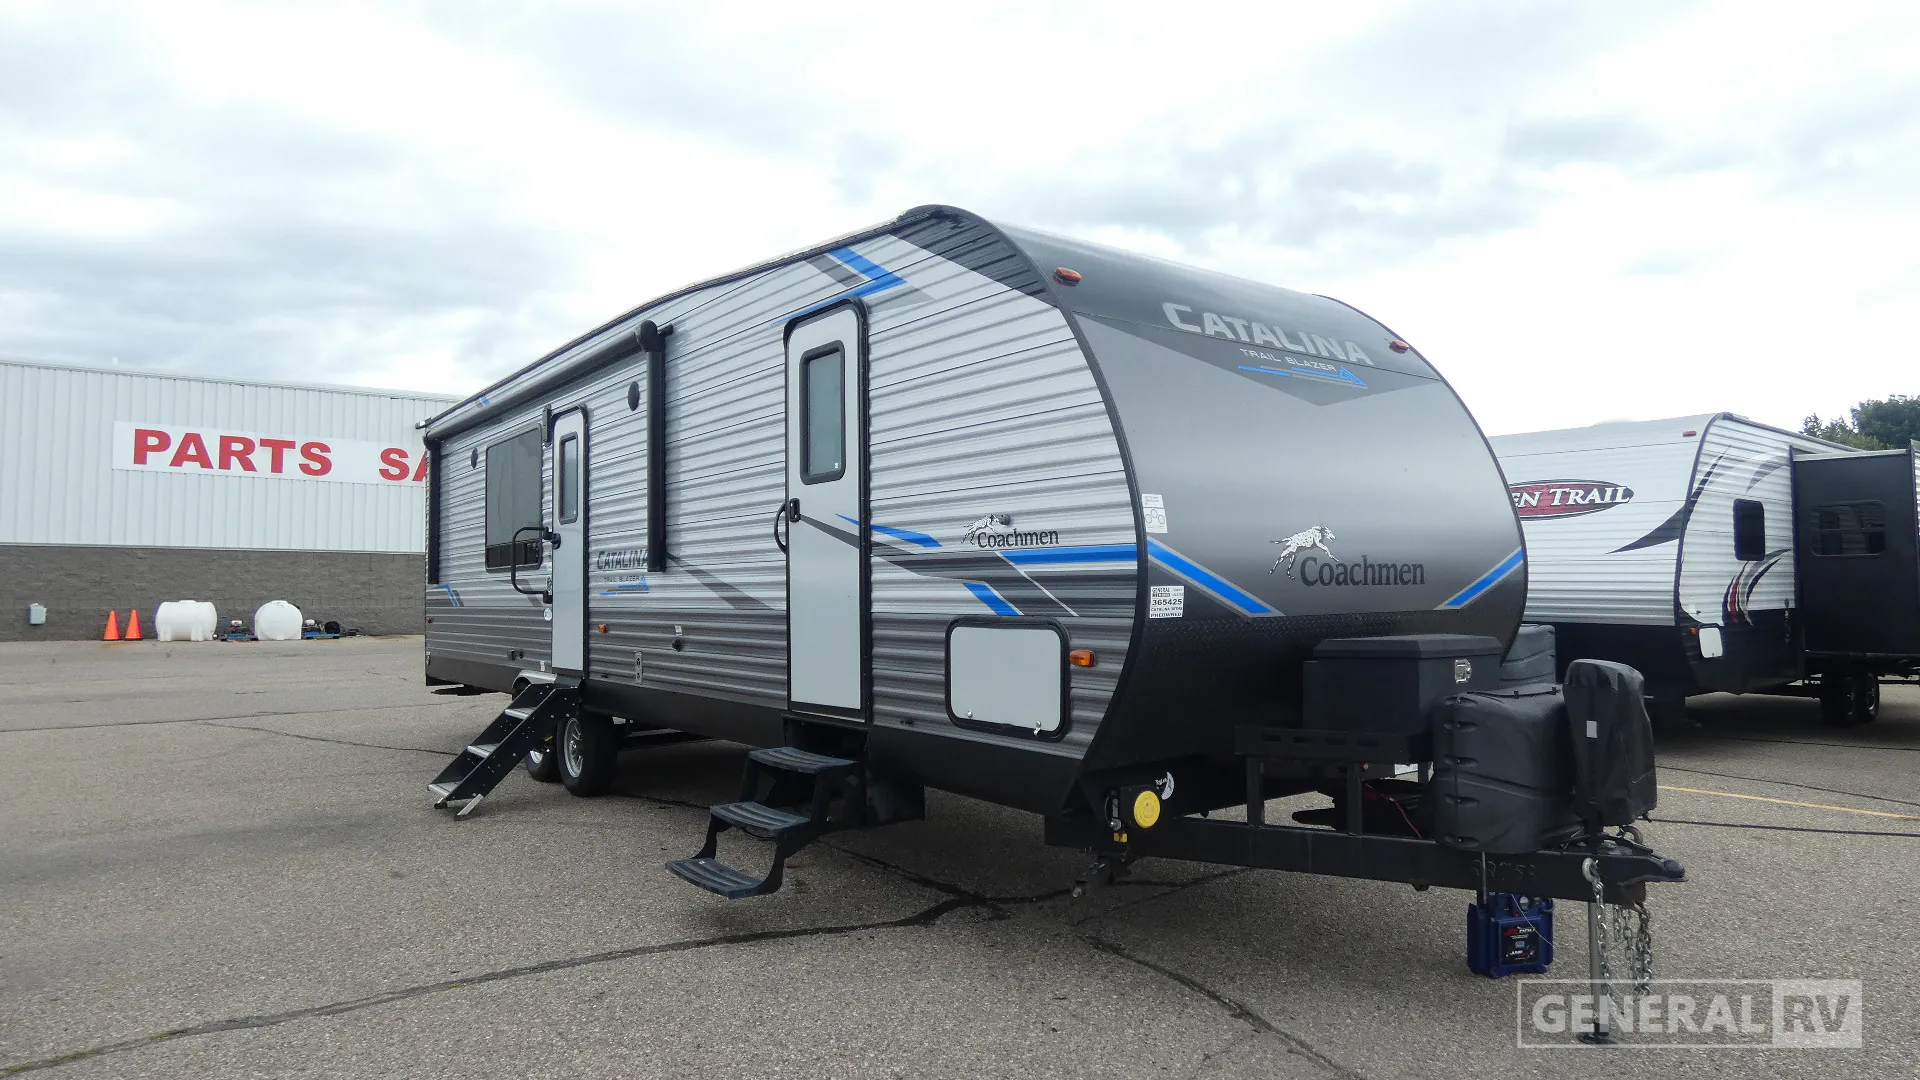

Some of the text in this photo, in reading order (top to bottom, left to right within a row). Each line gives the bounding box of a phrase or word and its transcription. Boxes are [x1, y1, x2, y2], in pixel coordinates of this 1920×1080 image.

[1162, 302, 1375, 366] CATALINA
[1239, 348, 1337, 372] TRAIL BLAZER
[132, 428, 333, 477] PARTS
[1549, 486, 1631, 506] TRAIL
[977, 528, 1060, 548] Coachmen
[1300, 554, 1426, 587] Coachmen
[1152, 598, 1183, 606] 365425
